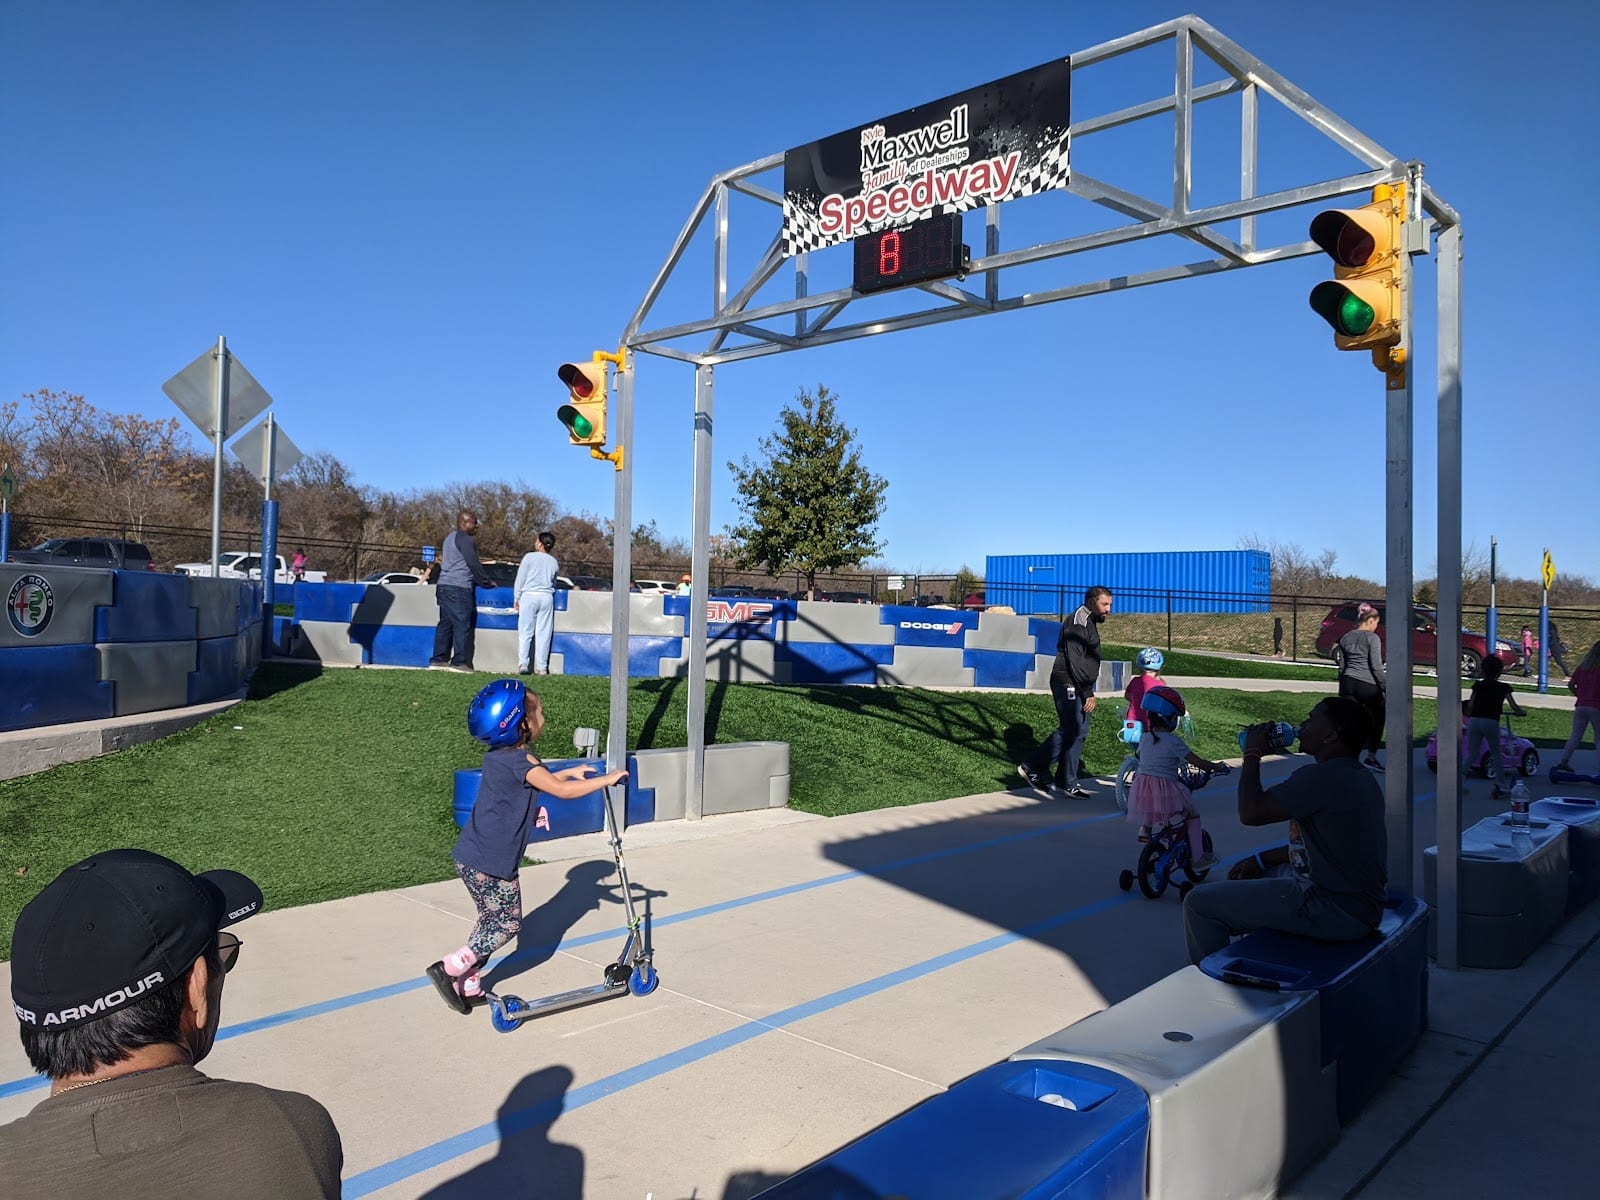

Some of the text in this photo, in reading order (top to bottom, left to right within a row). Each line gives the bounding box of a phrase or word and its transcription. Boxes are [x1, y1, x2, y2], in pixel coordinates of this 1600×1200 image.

[862, 107, 968, 170] Maxwell
[863, 127, 884, 142] Nyle
[862, 149, 968, 196] Family of Dealerships
[820, 154, 1019, 236] Speedway
[880, 232, 899, 275] 8
[9, 576, 53, 607] ALFA ROMEO
[900, 621, 953, 631] DODGE
[235, 901, 257, 917] GOLF
[13, 971, 165, 1026] ER ARMOUR
